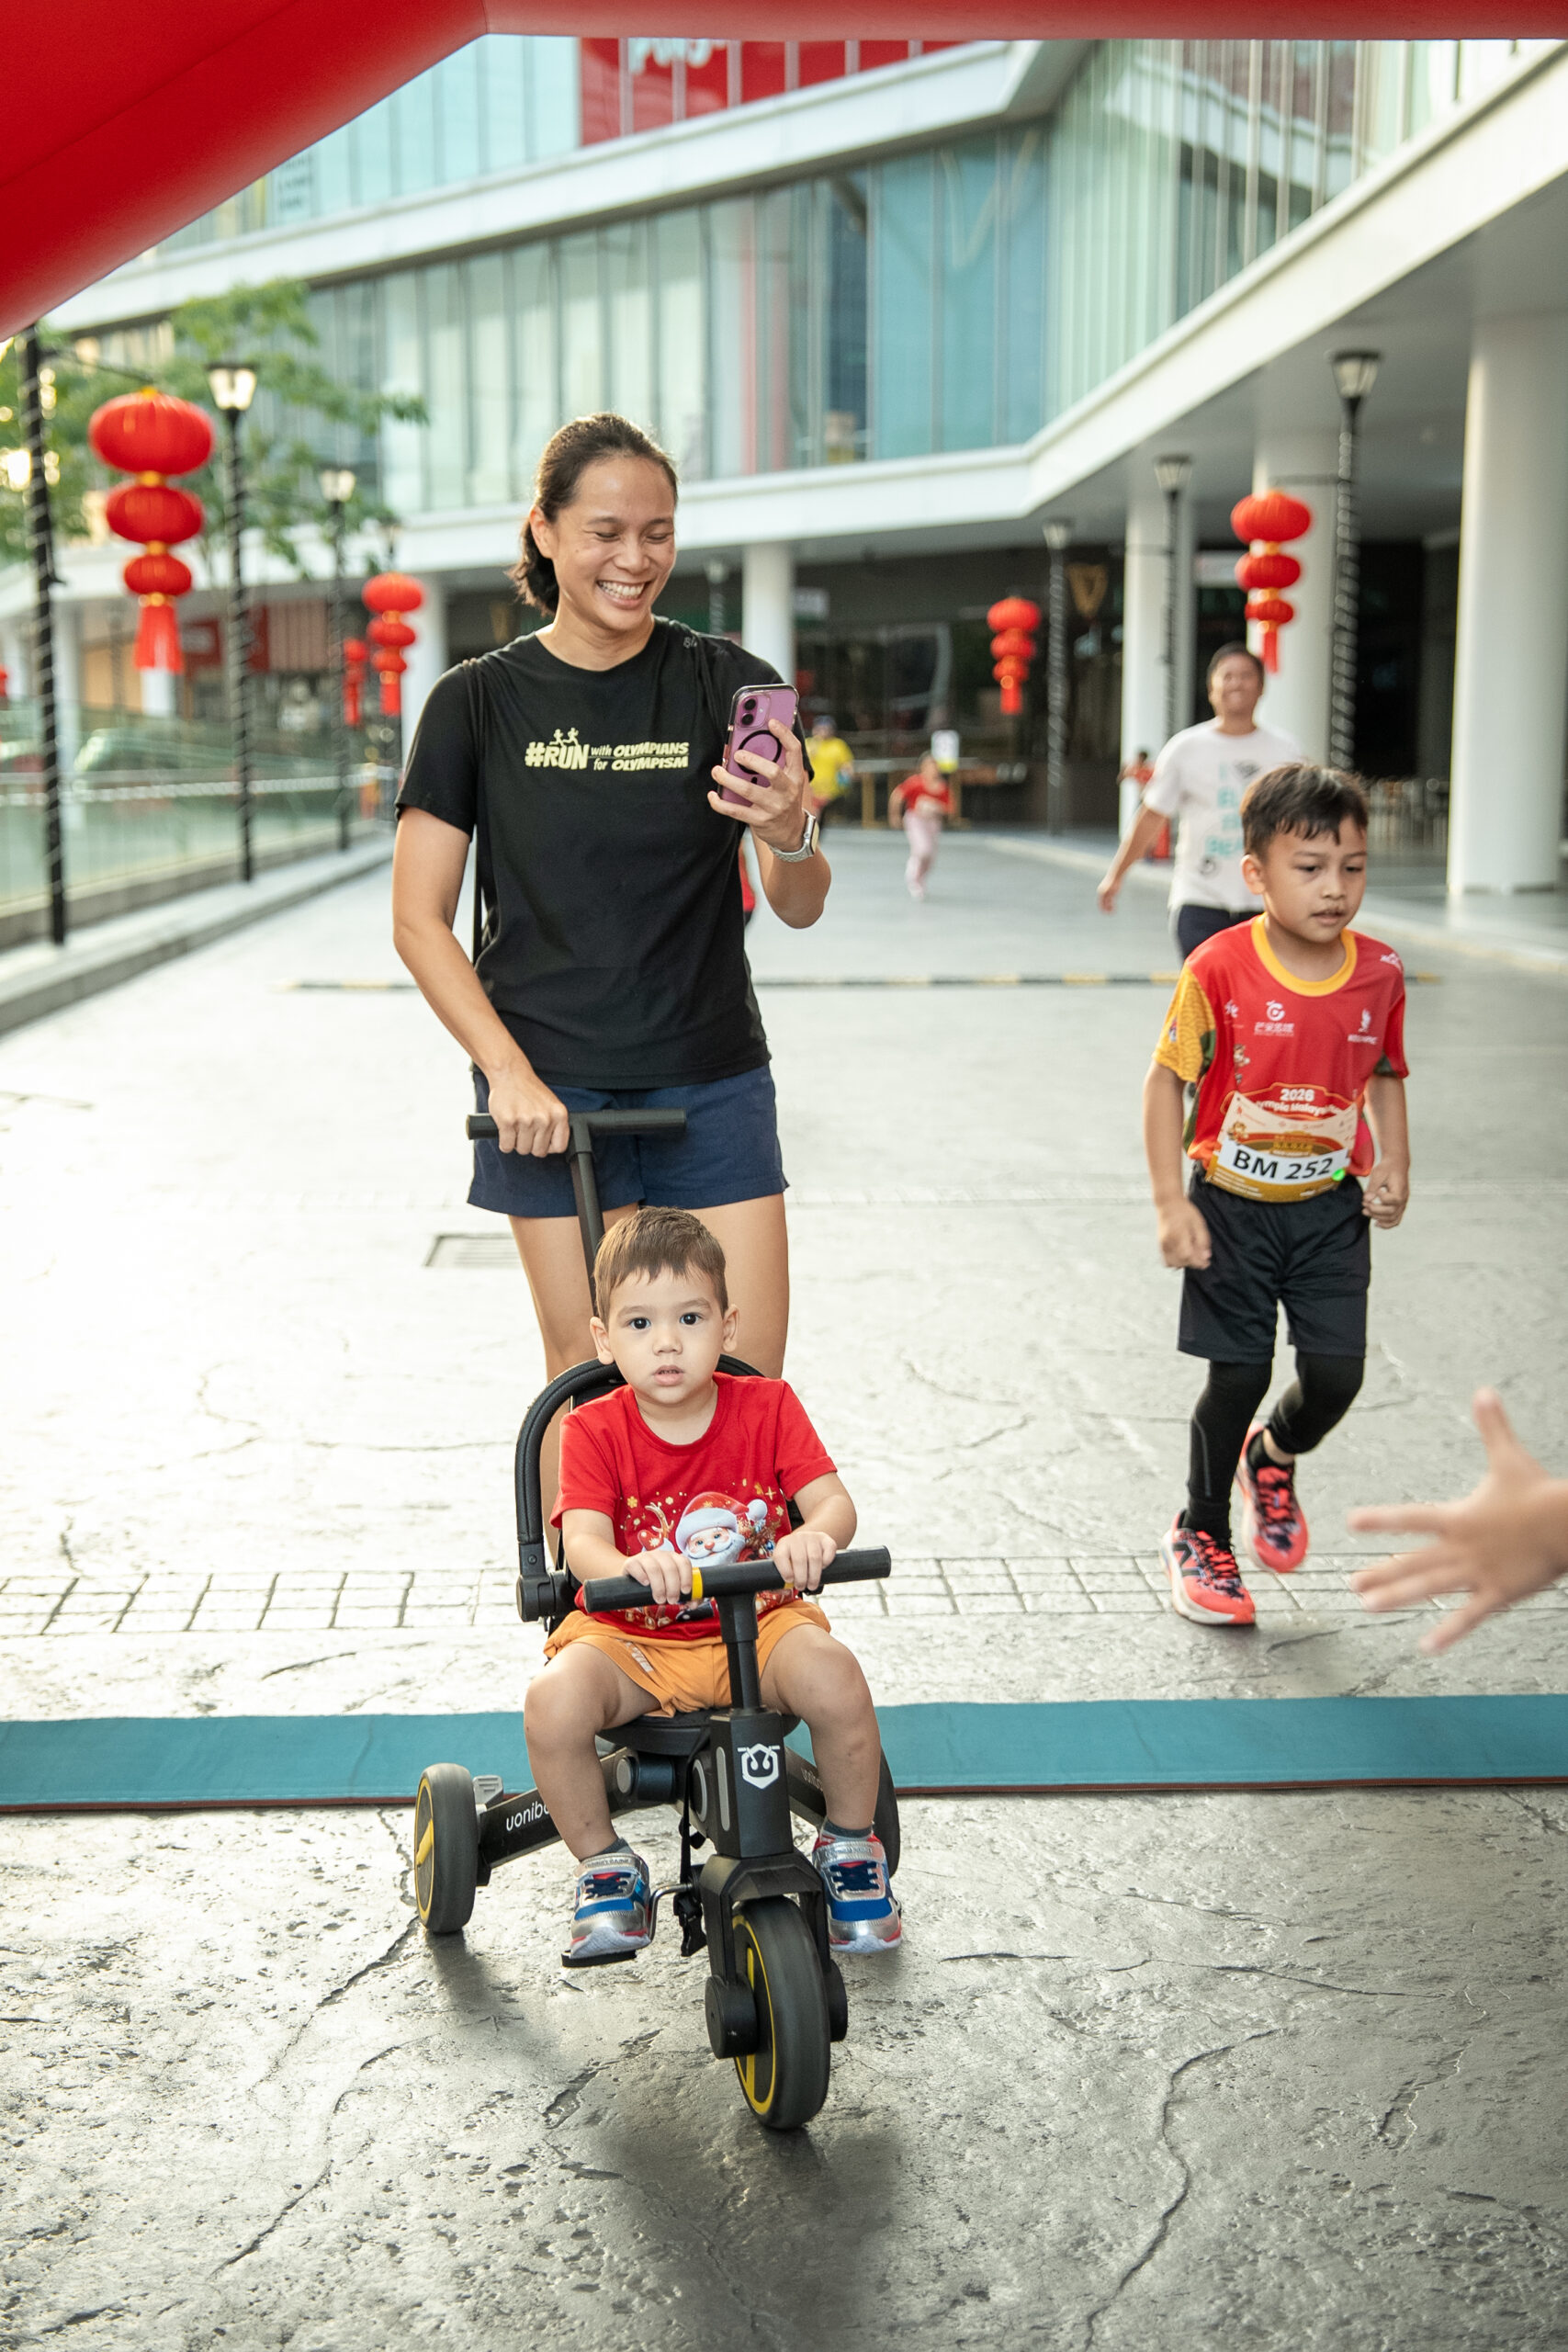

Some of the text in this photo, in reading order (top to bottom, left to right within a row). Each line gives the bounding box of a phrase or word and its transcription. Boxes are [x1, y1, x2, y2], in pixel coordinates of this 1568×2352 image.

[525, 741, 590, 770] #RUN
[591, 741, 690, 757] with OLYMPIANS
[592, 755, 689, 771] for OLYMPISM
[1233, 1148, 1334, 1180] BM 252
